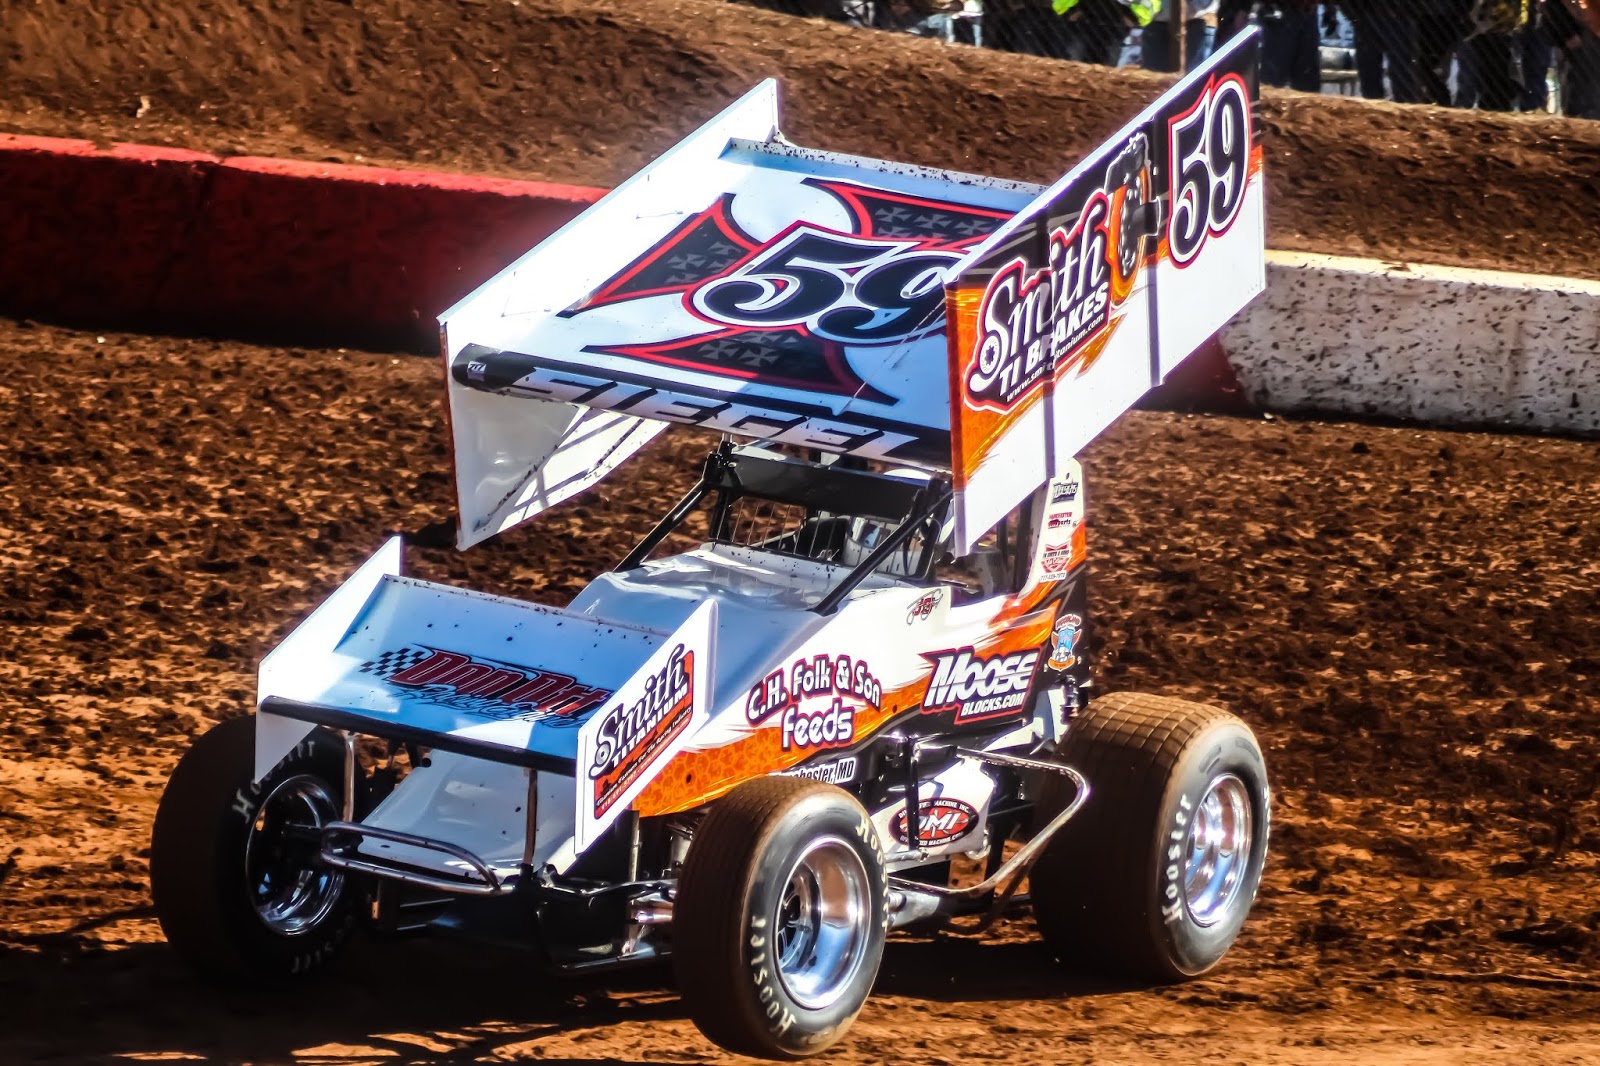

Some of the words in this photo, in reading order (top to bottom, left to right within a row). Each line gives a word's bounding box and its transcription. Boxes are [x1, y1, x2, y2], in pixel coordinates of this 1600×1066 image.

[1169, 78, 1251, 265] 59
[692, 225, 966, 345] 59
[970, 203, 1106, 393] Smith
[998, 356, 1021, 397] TI
[1025, 281, 1108, 375] BRAKES
[588, 643, 688, 780] Smith
[611, 683, 688, 768] TITANIUM
[747, 674, 787, 720] C.H.
[792, 659, 831, 697] Folk
[835, 659, 850, 692] &
[854, 664, 880, 709] Son
[782, 702, 852, 748] Feeds
[960, 691, 1026, 717] BLOCKS.COM
[837, 760, 855, 781] MD
